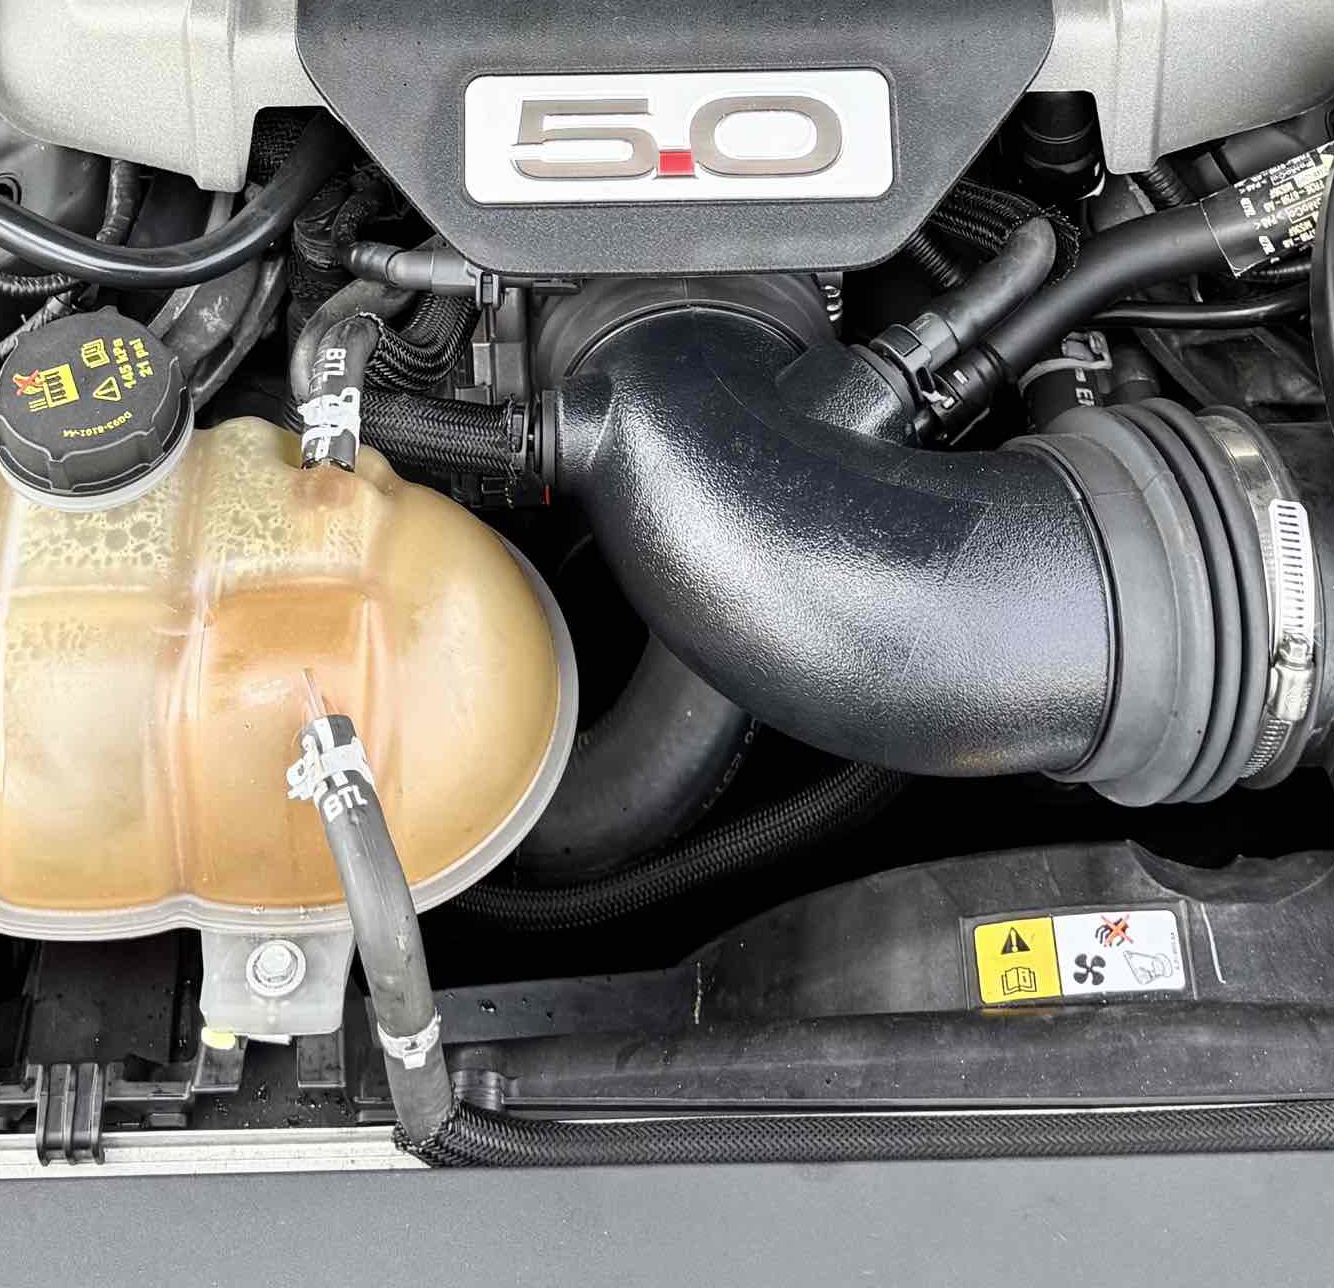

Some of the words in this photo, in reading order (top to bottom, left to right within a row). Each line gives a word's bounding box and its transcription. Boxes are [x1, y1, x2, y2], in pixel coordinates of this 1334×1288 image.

[511, 95, 844, 179] 5.0
[322, 347, 348, 382] BTL
[322, 784, 369, 823] BTL
